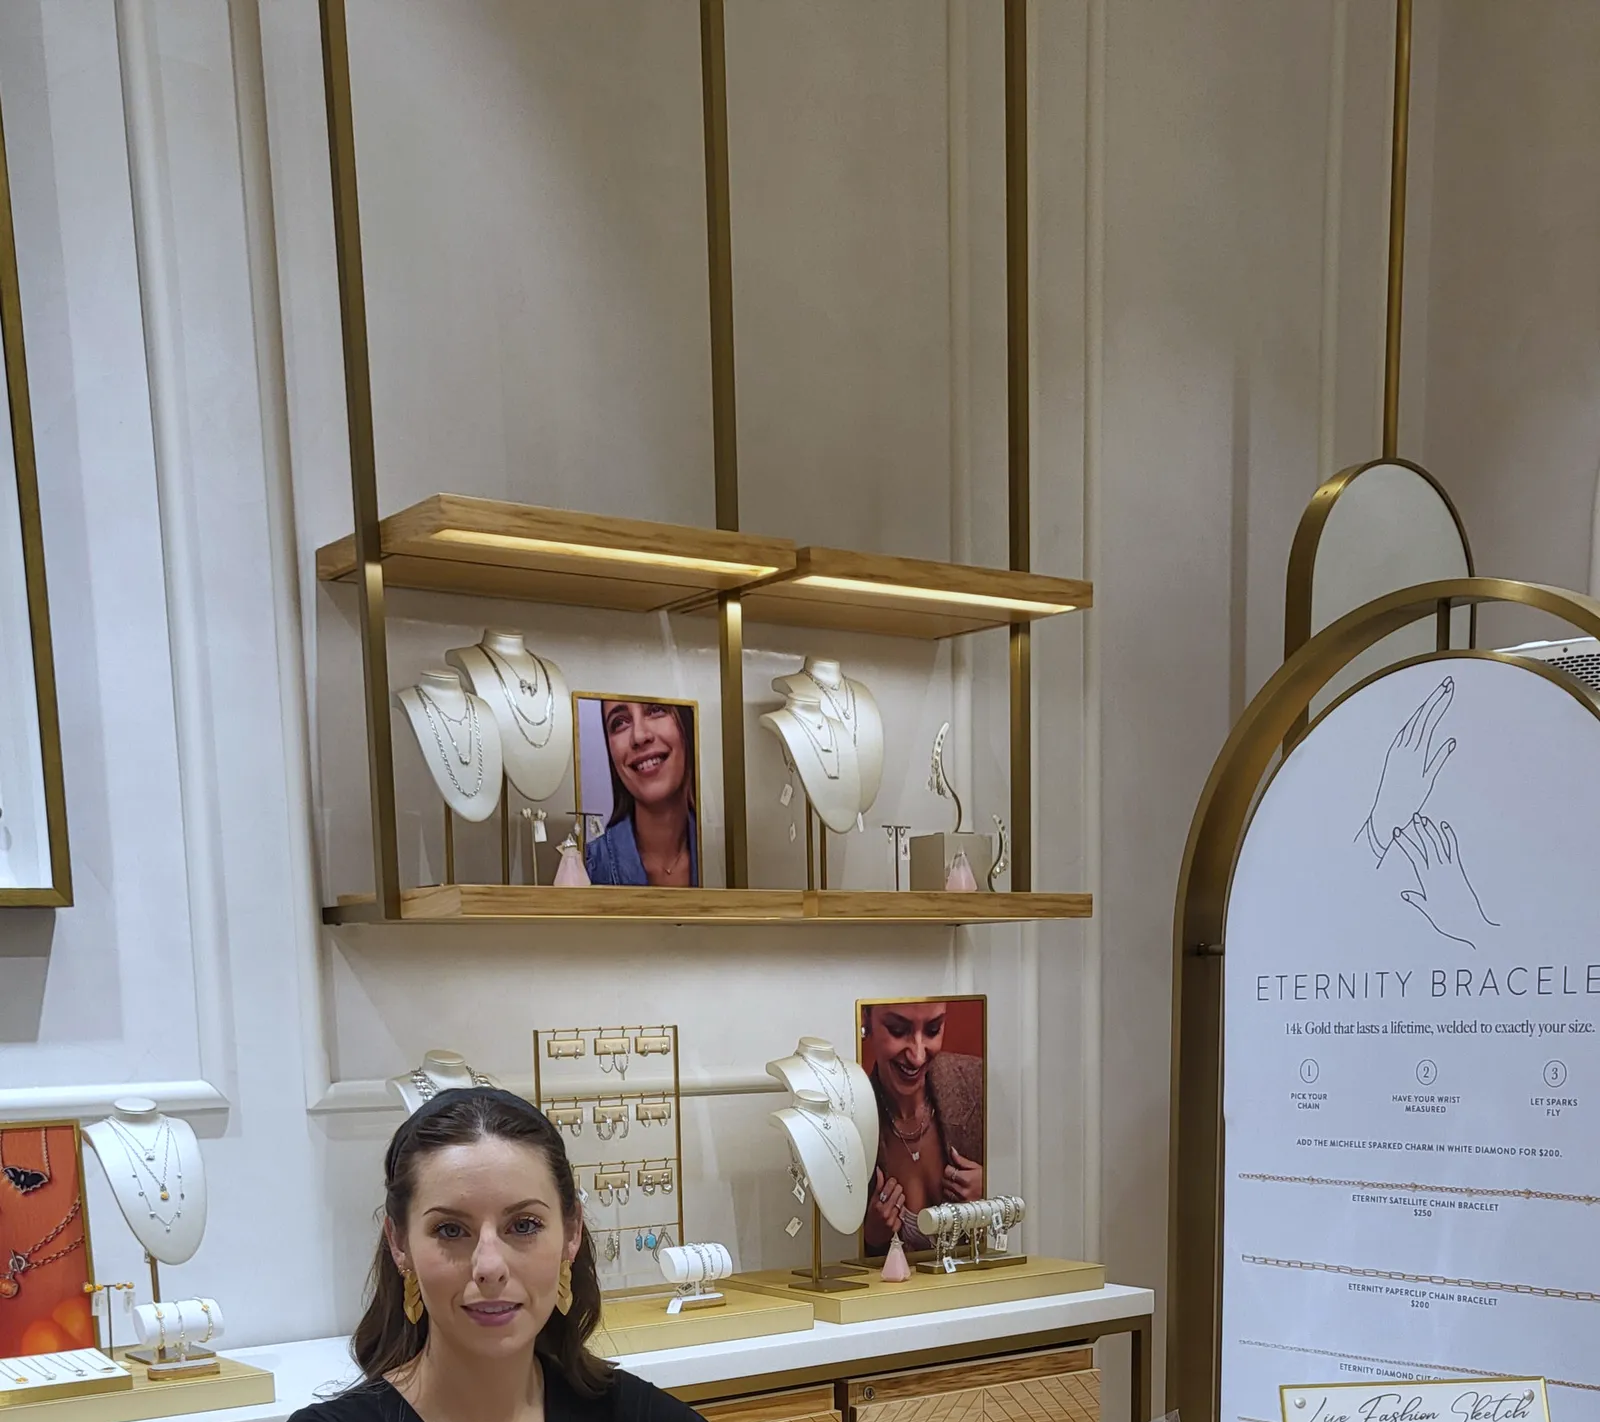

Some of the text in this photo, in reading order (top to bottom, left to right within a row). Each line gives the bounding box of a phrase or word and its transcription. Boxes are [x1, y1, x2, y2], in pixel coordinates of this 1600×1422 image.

[1257, 965, 1600, 1001] ETERNITY BRACELE
[1286, 1019, 1595, 1037] 14k Gold that lasts a lifetime, welded to exactly your size.
[1308, 1065, 1311, 1077] 1
[1423, 1066, 1429, 1078] 2
[1551, 1067, 1558, 1080] 3
[1414, 1095, 1435, 1103] YOUR
[1530, 1098, 1578, 1106] LET SPARKS
[1297, 1102, 1320, 1110] CHAIN
[1405, 1105, 1446, 1113] MEASURED
[1314, 1139, 1328, 1147] THE
[1329, 1140, 1366, 1148] MICHELLE
[1368, 1141, 1403, 1150] SPARKED
[1405, 1143, 1434, 1151] CHARM
[1447, 1145, 1472, 1153] WHITE
[1475, 1146, 1516, 1155] DIAMOND
[1519, 1148, 1536, 1156] FOR
[1539, 1149, 1562, 1157] $200.
[1352, 1194, 1499, 1211] ETERNITY SATELLITE CHAIN BRACELET
[1414, 1209, 1432, 1217] $250
[1348, 1283, 1498, 1306] ETERNITY PAPERCLIP CHAIN BRACELET
[1411, 1300, 1429, 1309] $200
[1339, 1362, 1374, 1375] ETERNITY
[1376, 1368, 1414, 1380] DIAMOND
